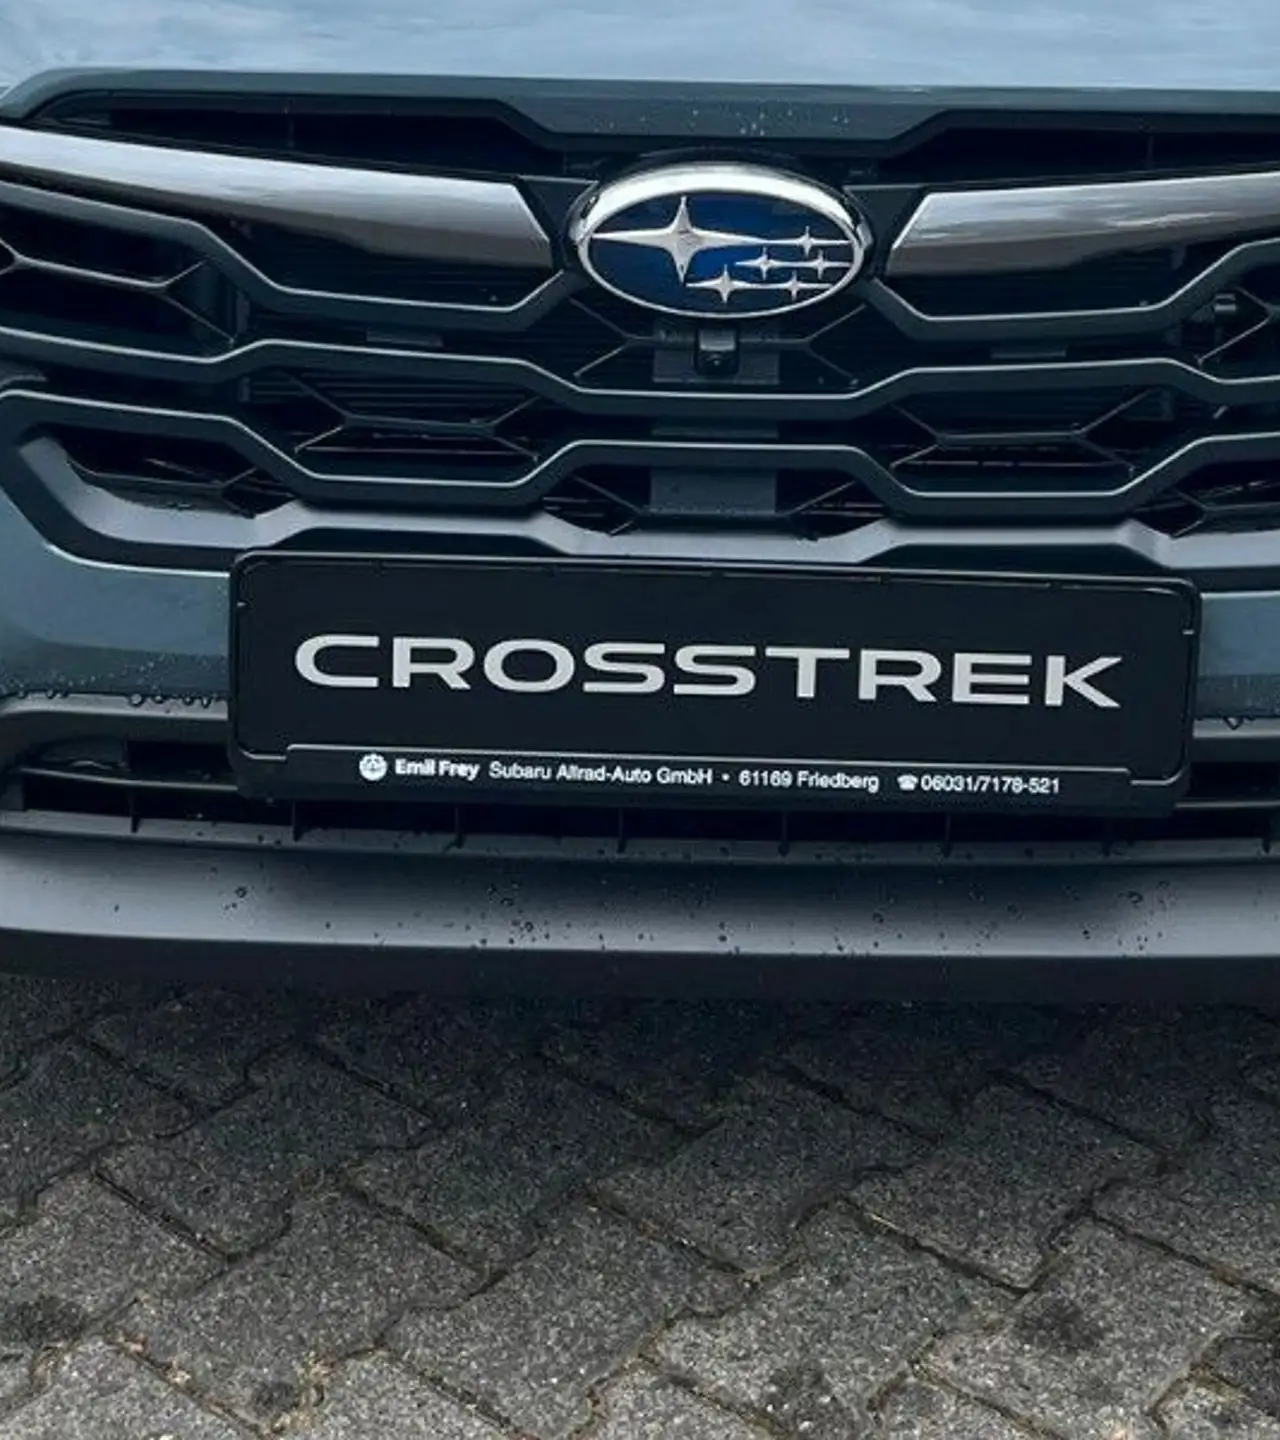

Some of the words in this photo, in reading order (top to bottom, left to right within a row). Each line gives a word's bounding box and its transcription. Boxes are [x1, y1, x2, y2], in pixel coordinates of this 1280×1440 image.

[295, 634, 1122, 709] CROSSTREK
[395, 758, 437, 775] Emil
[439, 760, 480, 781] Frey
[489, 761, 552, 780] Subaru
[556, 763, 652, 783] Allrad-Auto
[657, 767, 713, 785] GmbH
[738, 768, 793, 788] 61169
[796, 770, 880, 793] Friedberg
